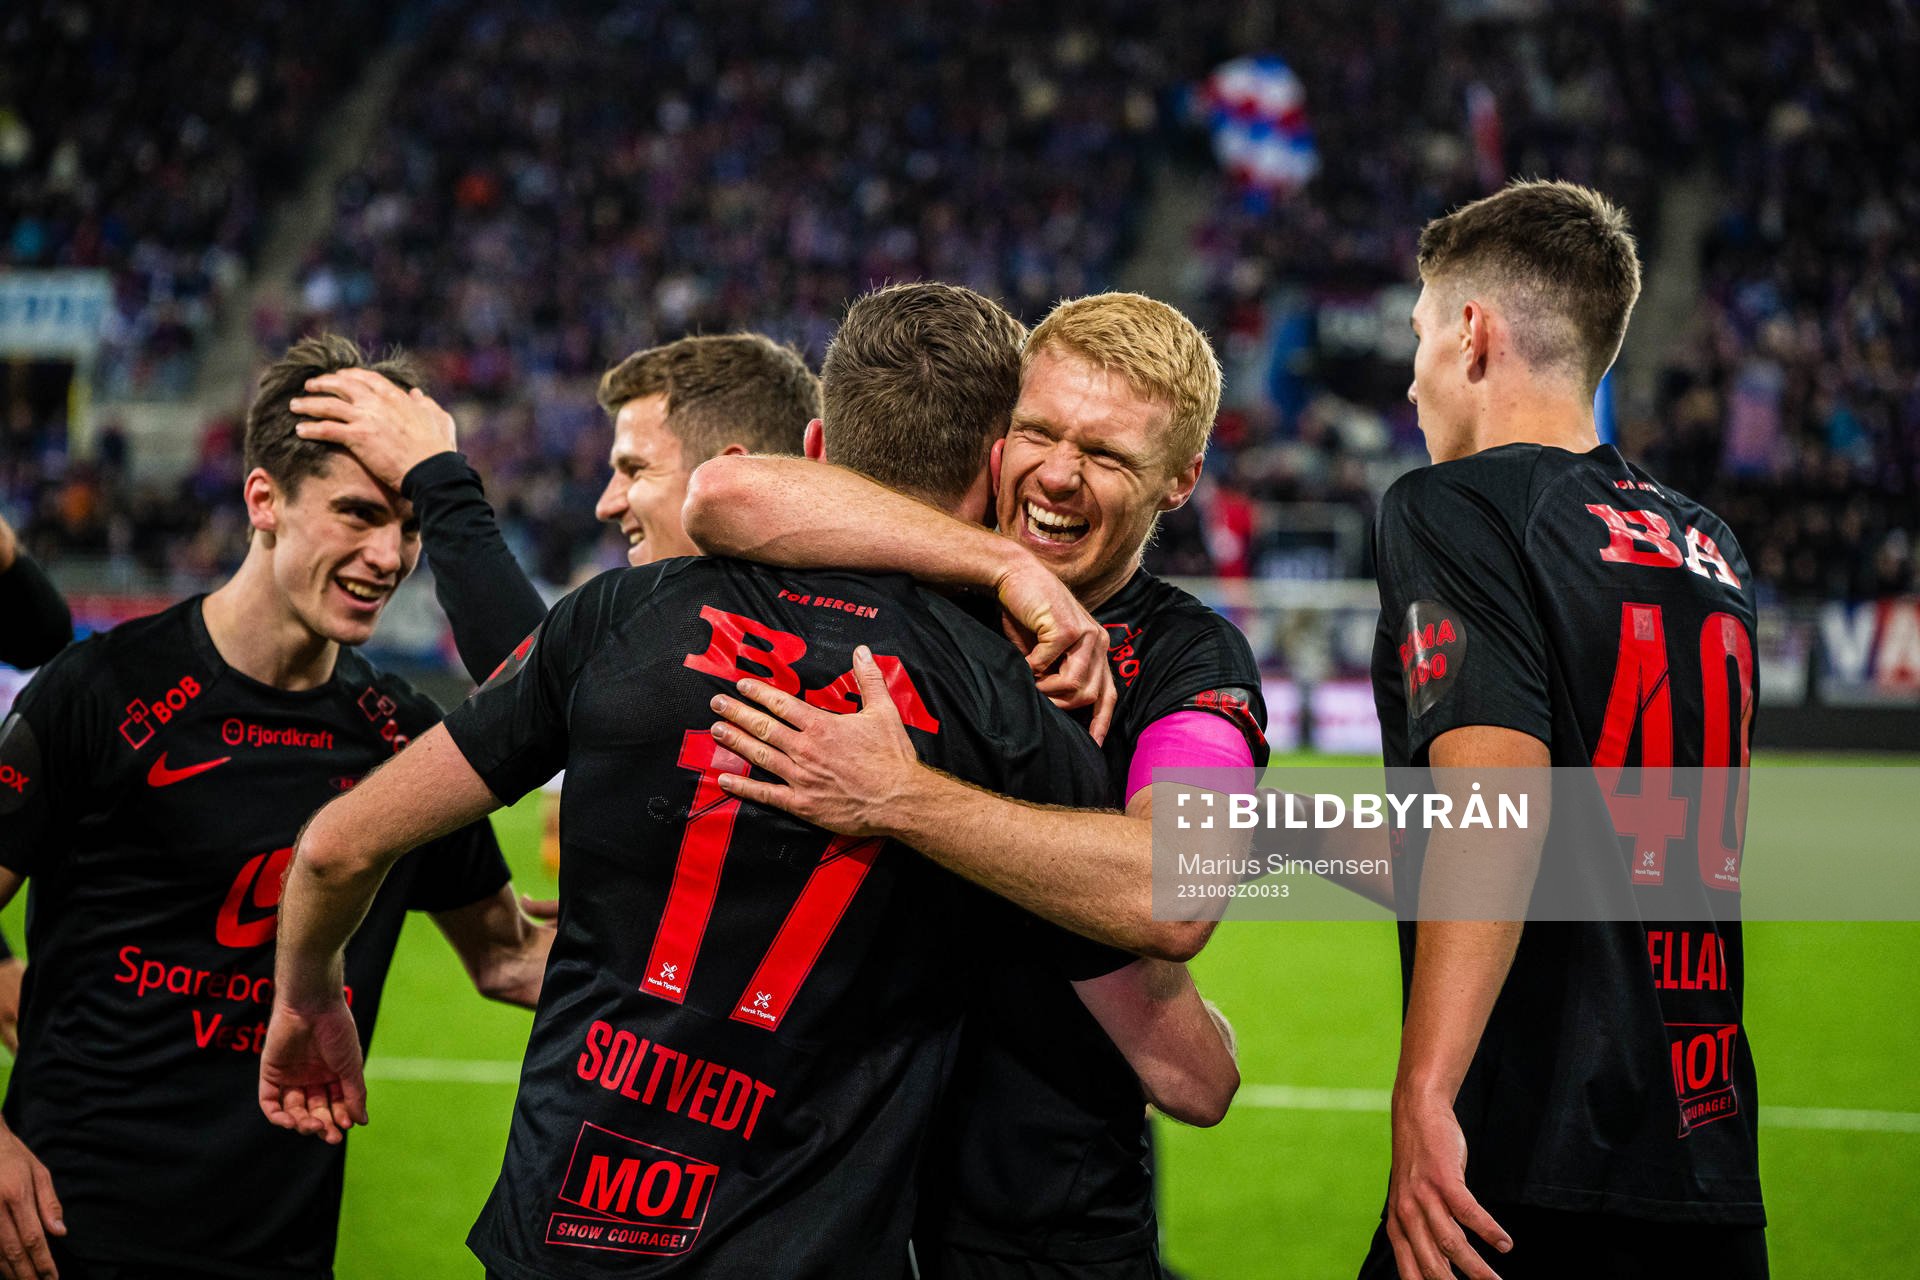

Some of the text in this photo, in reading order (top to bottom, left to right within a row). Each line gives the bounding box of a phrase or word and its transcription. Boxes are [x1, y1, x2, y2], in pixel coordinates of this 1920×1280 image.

[1585, 504, 1742, 590] BA
[777, 588, 879, 619] FOR BERGEN
[683, 605, 939, 734] BA
[151, 675, 201, 725] BOB
[247, 724, 334, 750] Fjordkraft
[1592, 601, 1754, 892] 40
[638, 729, 888, 1032] 17
[647, 976, 682, 993] Norsk Tipping
[1647, 931, 1727, 991] ELLA
[741, 1005, 776, 1022] Norsk Tipping
[576, 1020, 777, 1141] SOLTVEDT
[578, 1154, 720, 1220] MOT
[556, 1222, 687, 1248] SHOW COURAGE!
